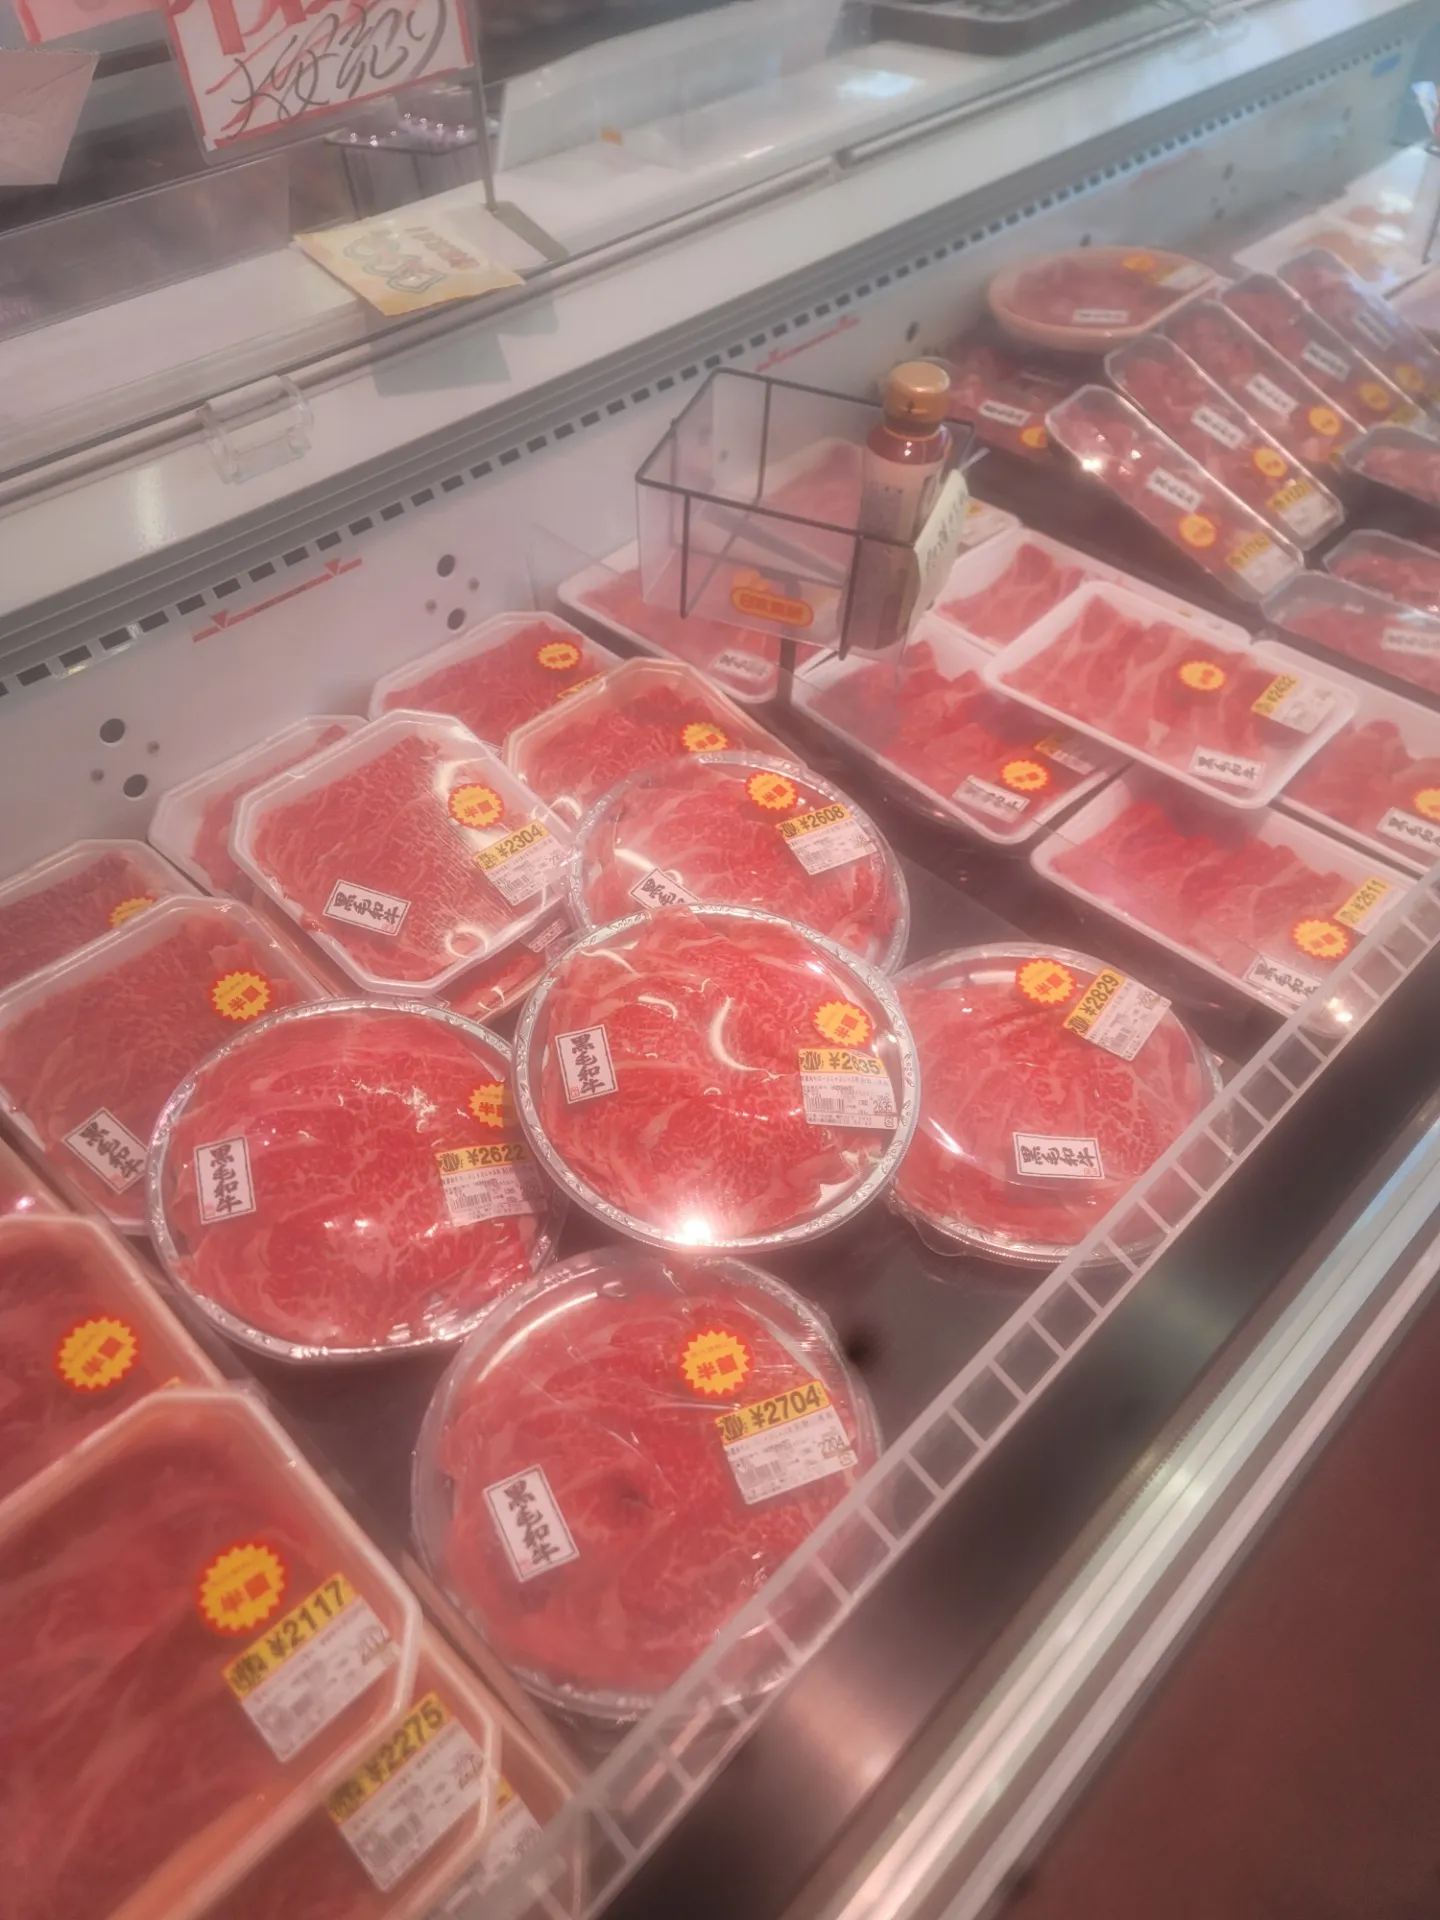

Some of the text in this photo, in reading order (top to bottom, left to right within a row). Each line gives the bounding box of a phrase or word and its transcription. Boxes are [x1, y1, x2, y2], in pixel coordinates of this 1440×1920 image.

[494, 823, 545, 859] ¥2304
[797, 804, 846, 833] ¥2608
[333, 891, 401, 925] 黒毛和牛
[1079, 973, 1120, 1018] ¥2829
[570, 1033, 607, 1096] 黒毛和牛
[828, 1051, 881, 1075] ¥2635
[77, 1120, 145, 1180] 黒毛和牛
[466, 1143, 528, 1167] ¥2622
[1020, 1145, 1097, 1169] 黒毛和牛
[209, 1143, 244, 1214] 黒毛和牛
[748, 1383, 822, 1430] ¥2704
[503, 1479, 561, 1565] 黒毛和牛
[266, 1579, 346, 1658] ¥2117
[362, 1698, 445, 1781] ¥2275
